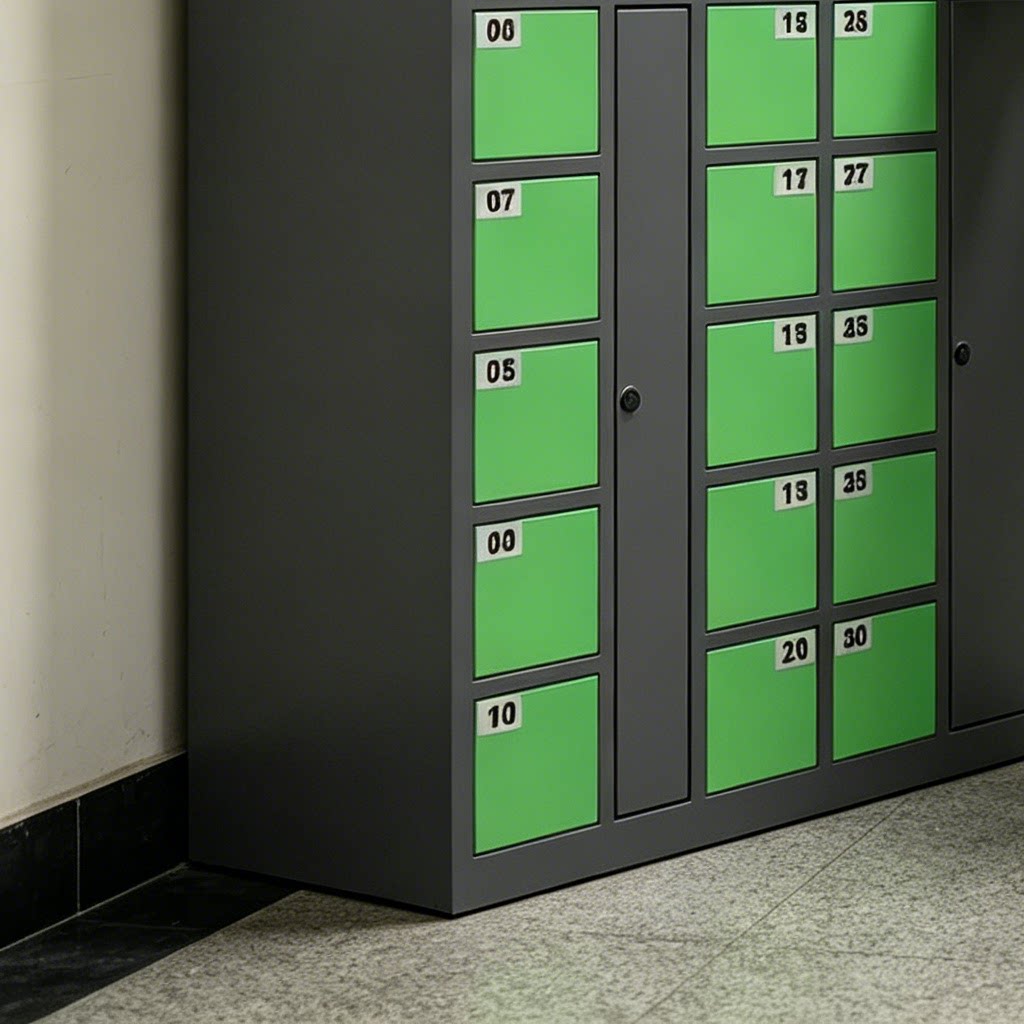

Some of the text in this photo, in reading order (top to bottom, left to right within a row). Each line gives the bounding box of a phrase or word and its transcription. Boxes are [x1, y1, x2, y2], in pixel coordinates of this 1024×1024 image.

[782, 167, 809, 191] 17
[486, 188, 516, 213] 07
[781, 636, 809, 664] 20
[487, 700, 517, 729] 10
